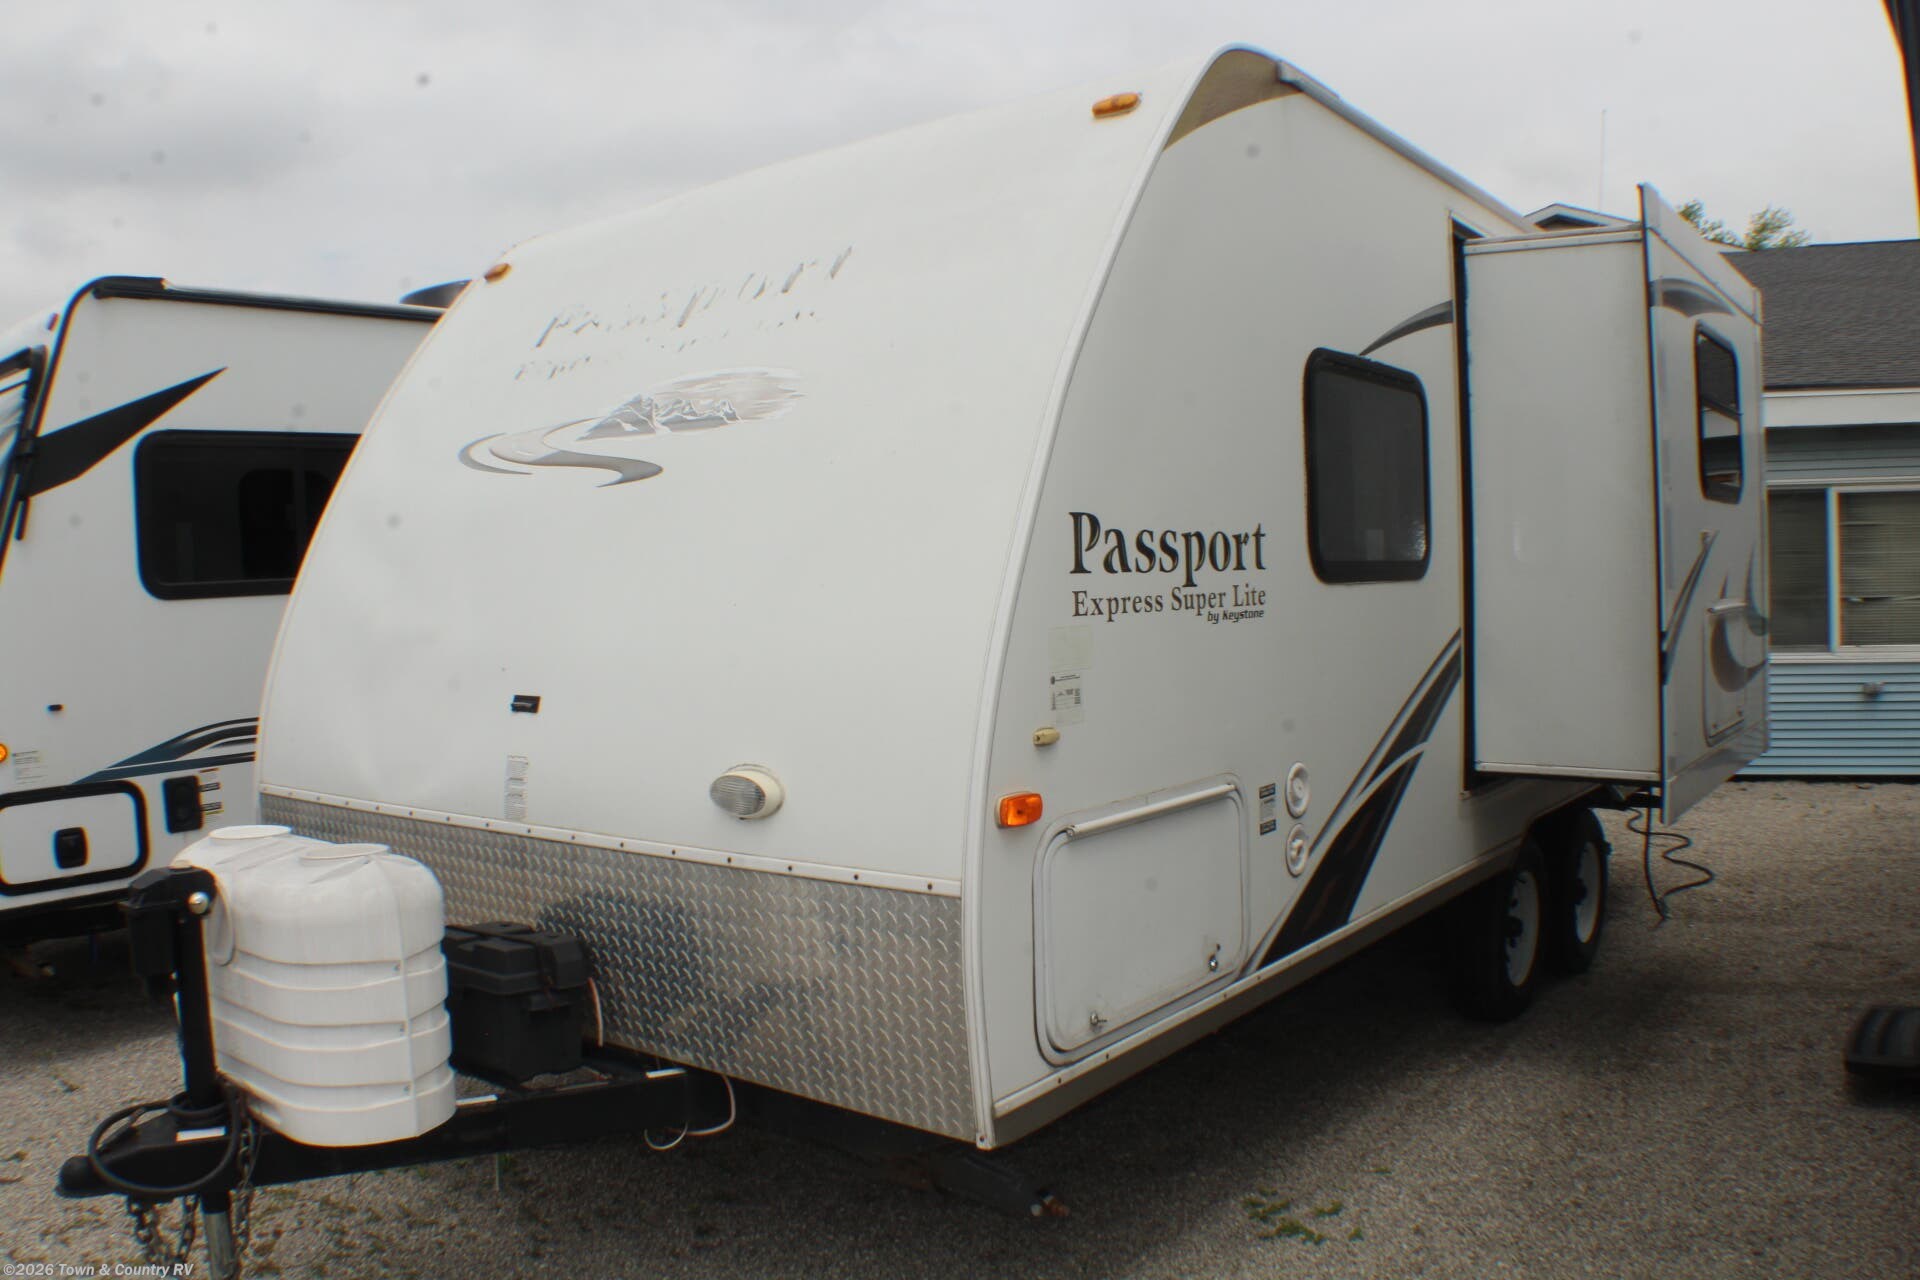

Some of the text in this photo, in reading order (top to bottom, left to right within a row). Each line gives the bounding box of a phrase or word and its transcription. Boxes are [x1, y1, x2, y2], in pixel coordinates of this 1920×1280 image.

[535, 246, 853, 349] Paport
[1068, 511, 1267, 588] Passport
[1072, 583, 1266, 622] Express Super Lite
[1207, 609, 1265, 625] by Keystone
